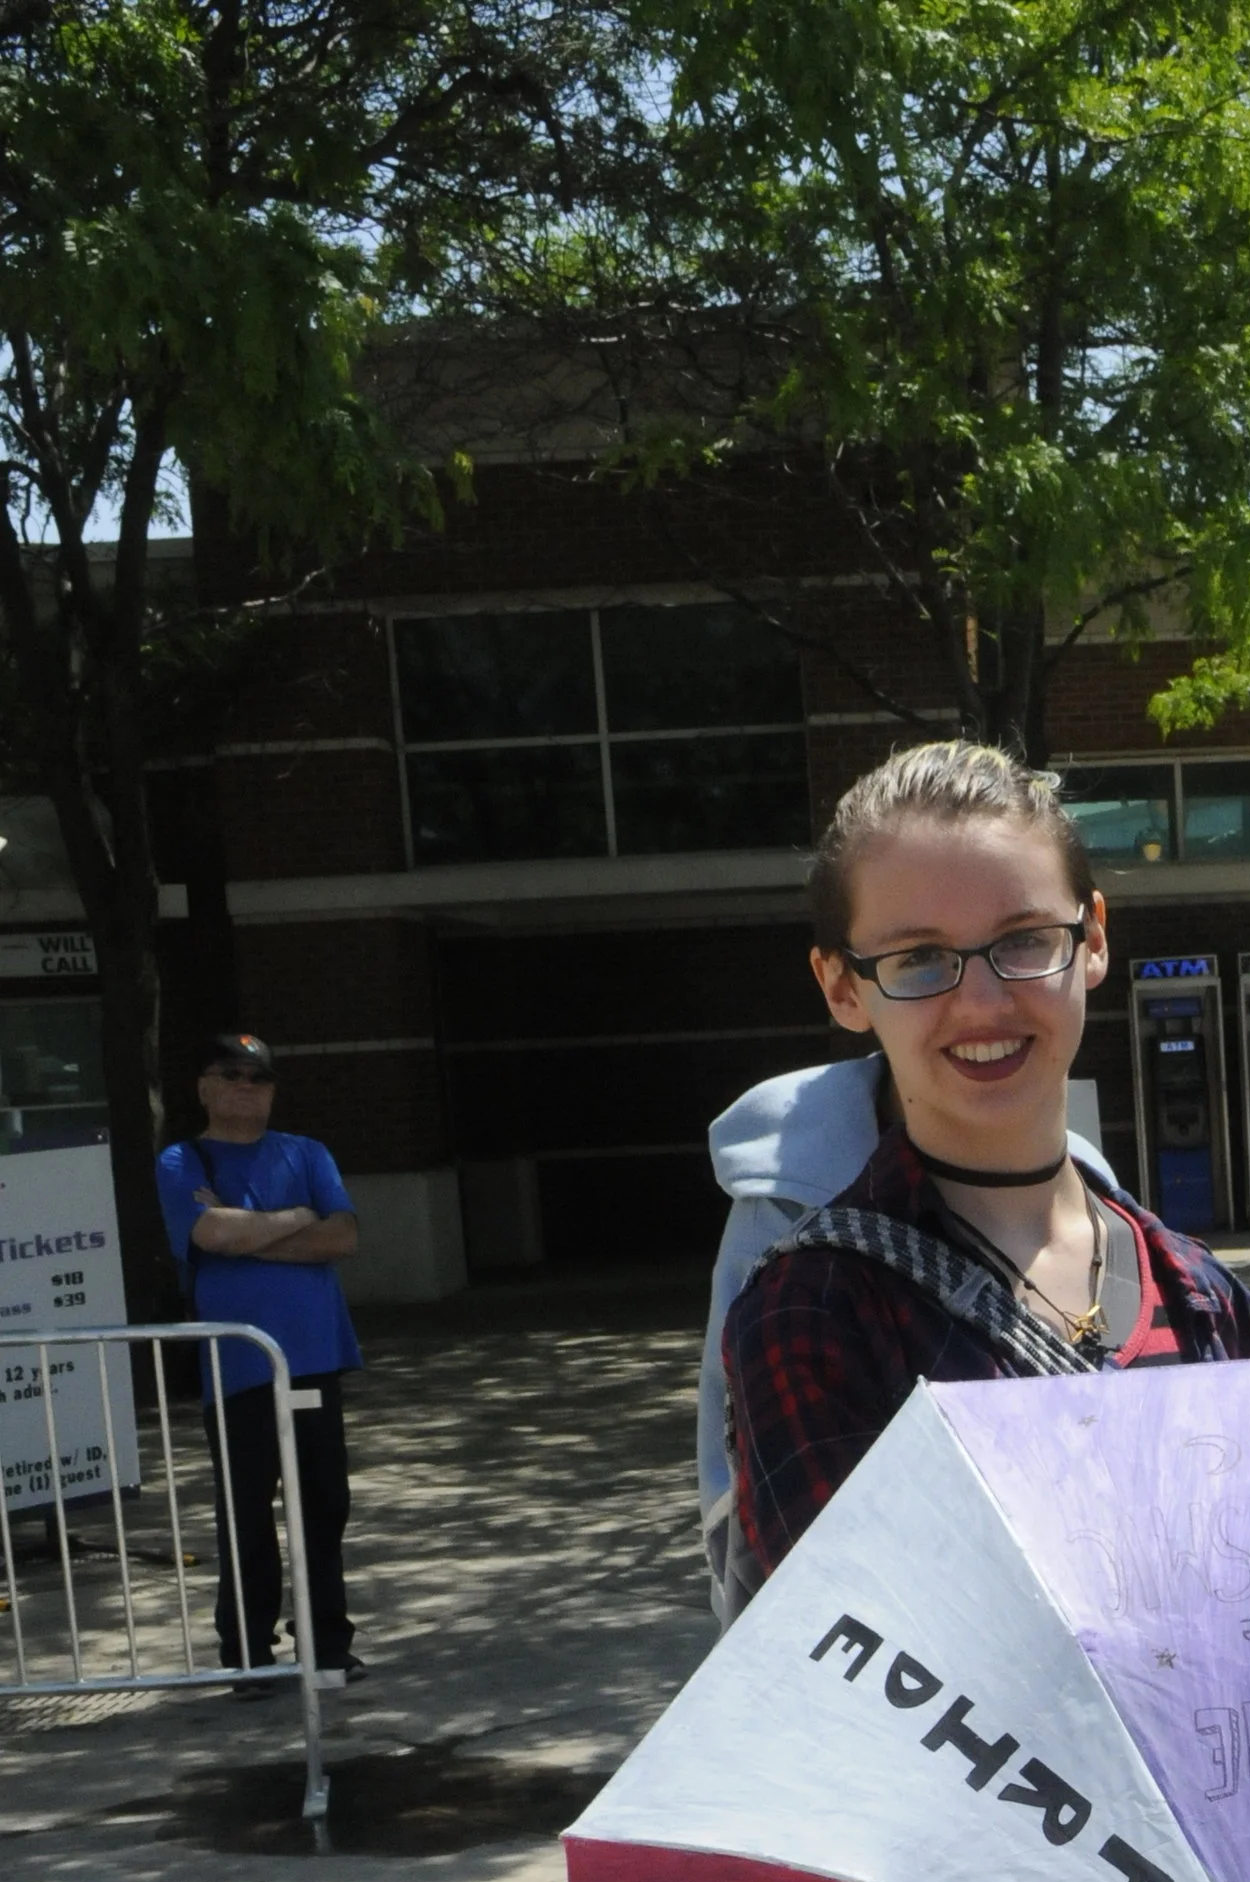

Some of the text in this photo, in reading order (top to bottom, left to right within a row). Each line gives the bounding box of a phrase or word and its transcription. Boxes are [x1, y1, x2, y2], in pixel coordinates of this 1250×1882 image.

[38, 935, 91, 953] WILL
[41, 956, 93, 973] CALL
[1140, 958, 1210, 979] ATM
[5, 1360, 75, 1382] 12 yars
